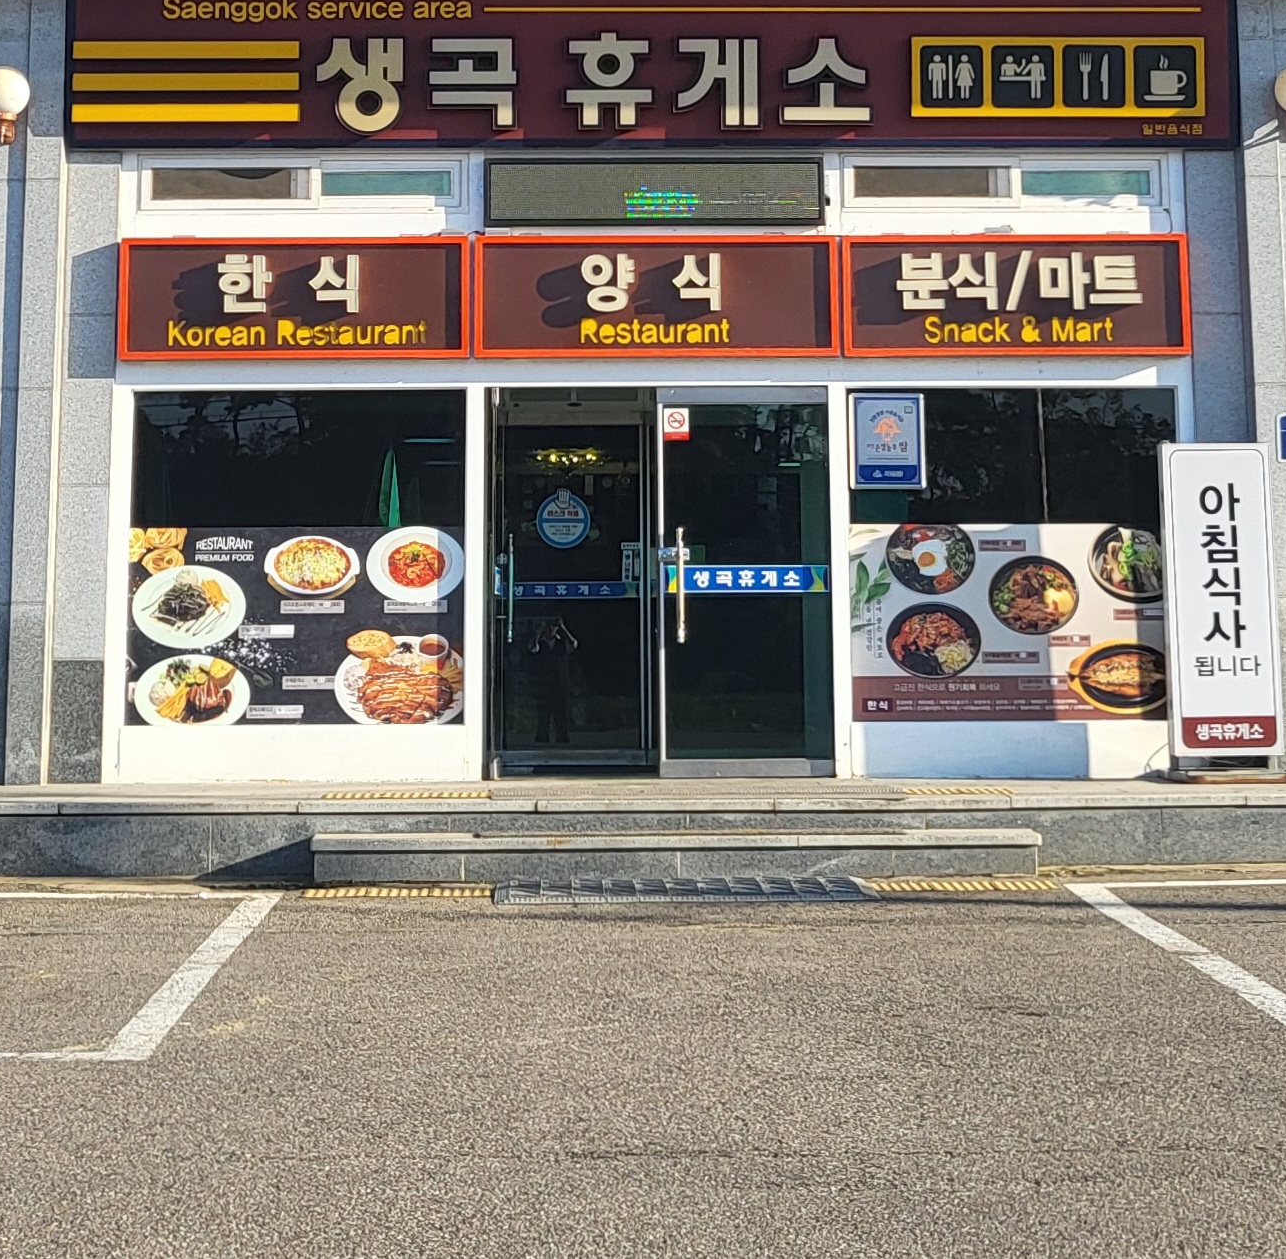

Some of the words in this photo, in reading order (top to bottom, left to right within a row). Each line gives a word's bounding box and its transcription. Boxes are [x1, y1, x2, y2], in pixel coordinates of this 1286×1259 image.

[307, 0, 404, 20] service
[413, 0, 473, 20] area
[314, 37, 519, 133] 생곡
[565, 31, 872, 129] 휴게소
[1141, 123, 1203, 135] 일반음식점
[216, 253, 360, 314] 한식
[580, 252, 722, 313] 양식
[895, 250, 1144, 312] 분식/마트
[167, 319, 267, 347] Korean
[276, 319, 428, 347] Restaurant
[580, 318, 731, 345] Restaurant
[923, 316, 1012, 345] Snack
[1020, 315, 1043, 344] &
[1051, 316, 1114, 343] Mart
[194, 536, 255, 552] RESTAURANT
[194, 553, 231, 562] PREMIUM
[231, 553, 255, 562] FOOD
[1198, 482, 1246, 649] 아침식사
[692, 569, 801, 589] 생곡휴게소
[1193, 654, 1262, 677] 됩니다
[866, 700, 889, 711] 한식
[1195, 722, 1265, 741] 생곡휴게소
